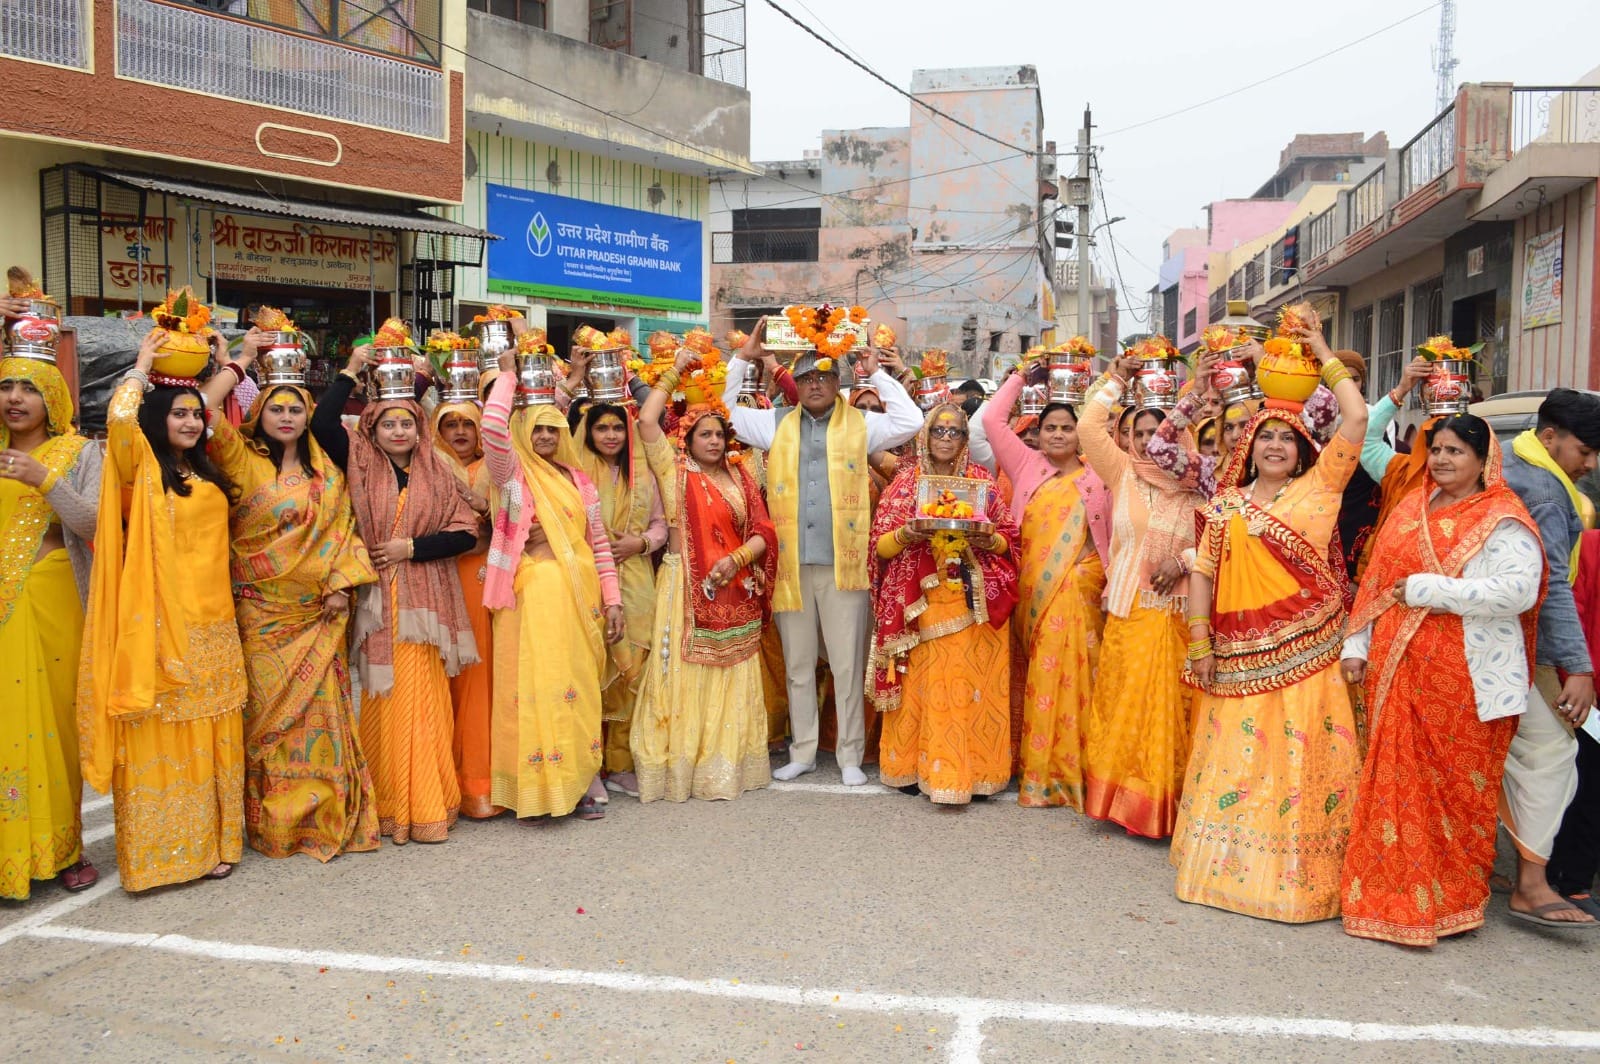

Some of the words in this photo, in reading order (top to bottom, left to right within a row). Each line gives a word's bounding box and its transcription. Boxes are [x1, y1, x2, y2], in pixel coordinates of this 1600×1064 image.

[556, 222, 583, 240] उत्तर
[584, 223, 612, 245] प्रदेश
[613, 229, 649, 250] ग्रामीण
[126, 242, 152, 264] की
[556, 245, 586, 260] UTTAR
[587, 248, 626, 265] PRADESH
[626, 256, 659, 270] GRAMIN
[659, 260, 682, 273] BANK
